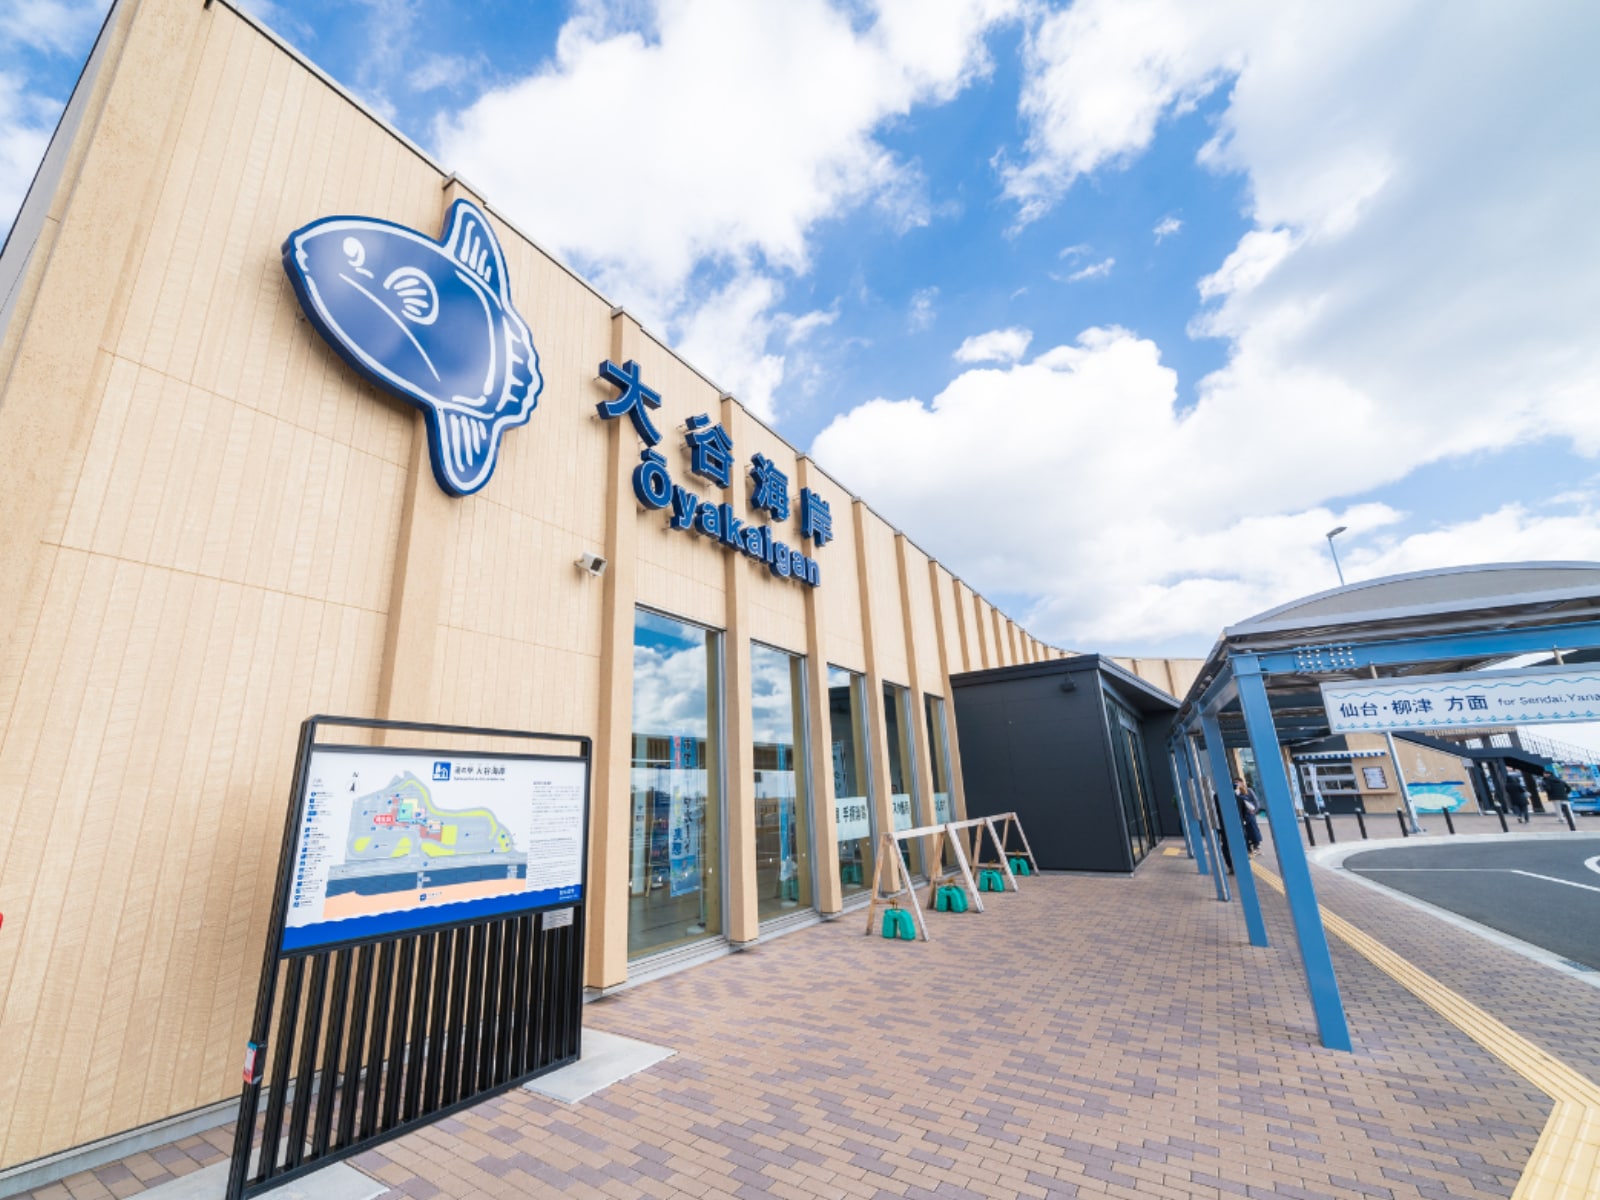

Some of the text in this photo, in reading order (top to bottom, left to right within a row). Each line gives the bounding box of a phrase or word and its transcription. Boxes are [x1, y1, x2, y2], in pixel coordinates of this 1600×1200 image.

[596, 359, 833, 547] 大谷海岸
[632, 448, 821, 588] Ōyakaigan
[1339, 695, 1488, 717] 仙台・柳津 方面
[1497, 697, 1516, 706] for
